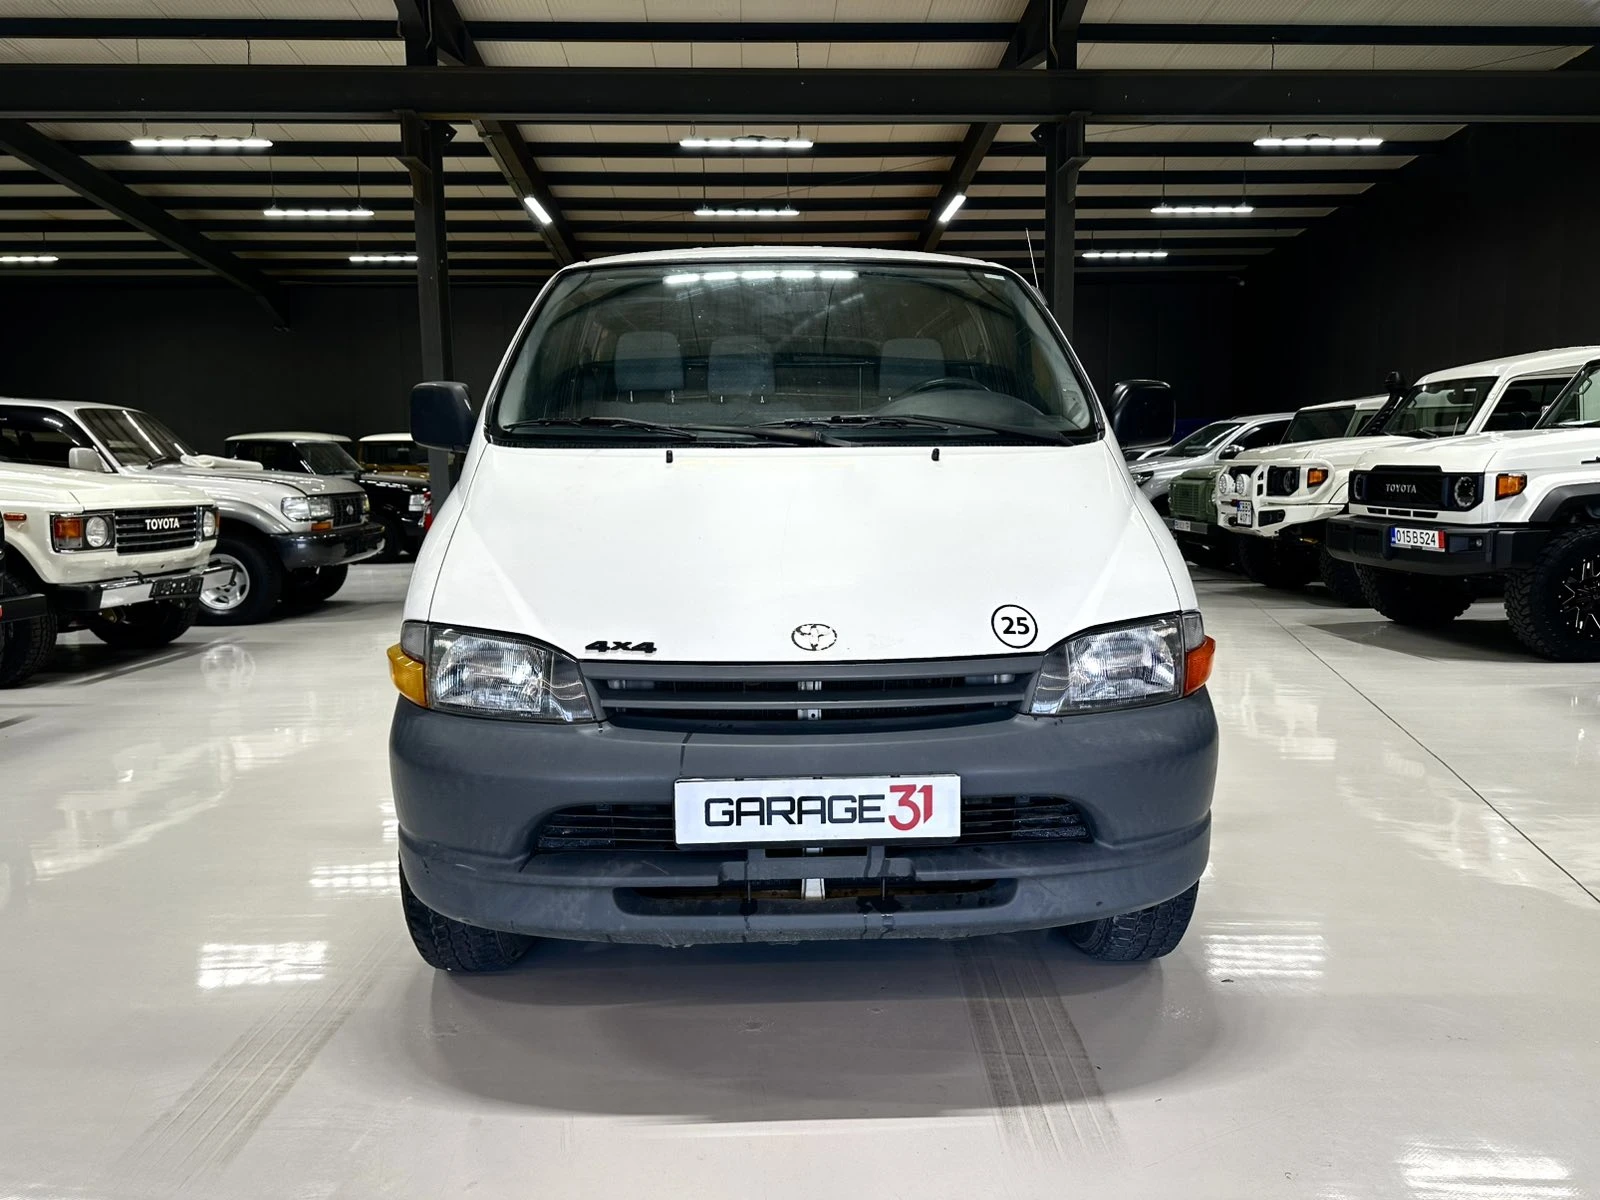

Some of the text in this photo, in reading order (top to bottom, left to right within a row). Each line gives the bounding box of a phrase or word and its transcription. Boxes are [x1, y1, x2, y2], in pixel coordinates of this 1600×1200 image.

[1385, 484, 1417, 494] TOYOTA
[145, 517, 180, 531] TOYOTA
[1000, 616, 1030, 635] 25
